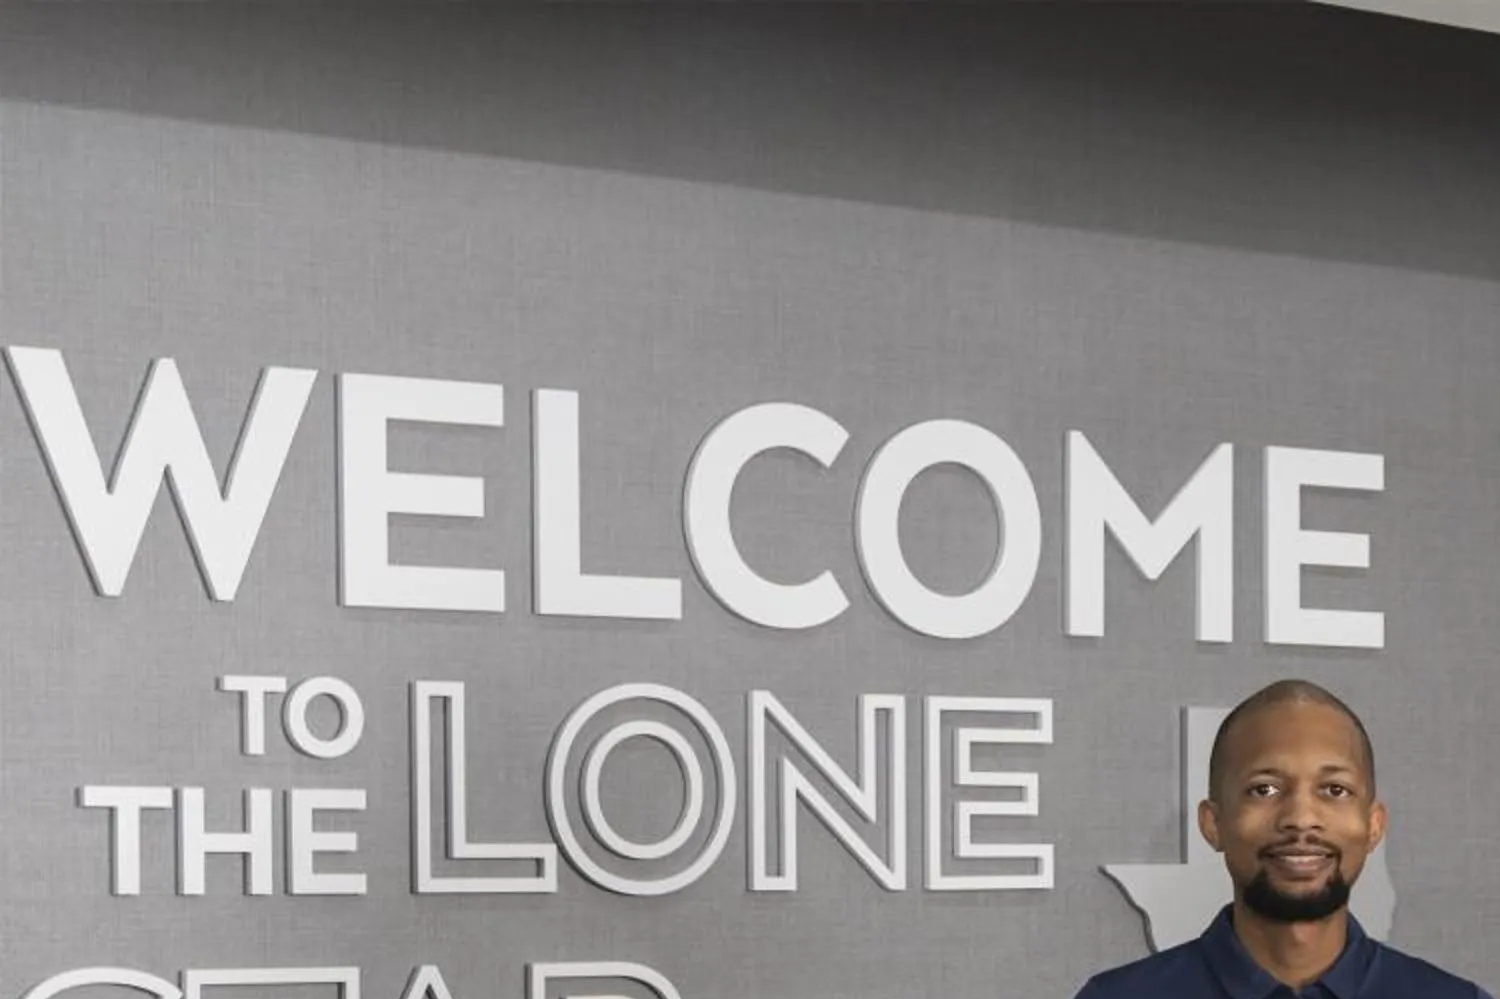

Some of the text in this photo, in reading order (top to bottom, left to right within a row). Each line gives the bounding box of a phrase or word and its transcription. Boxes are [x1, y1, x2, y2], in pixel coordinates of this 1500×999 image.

[5, 344, 1386, 648] WELCOME
[79, 680, 1054, 896] THE LONE
[219, 674, 365, 758] TO
